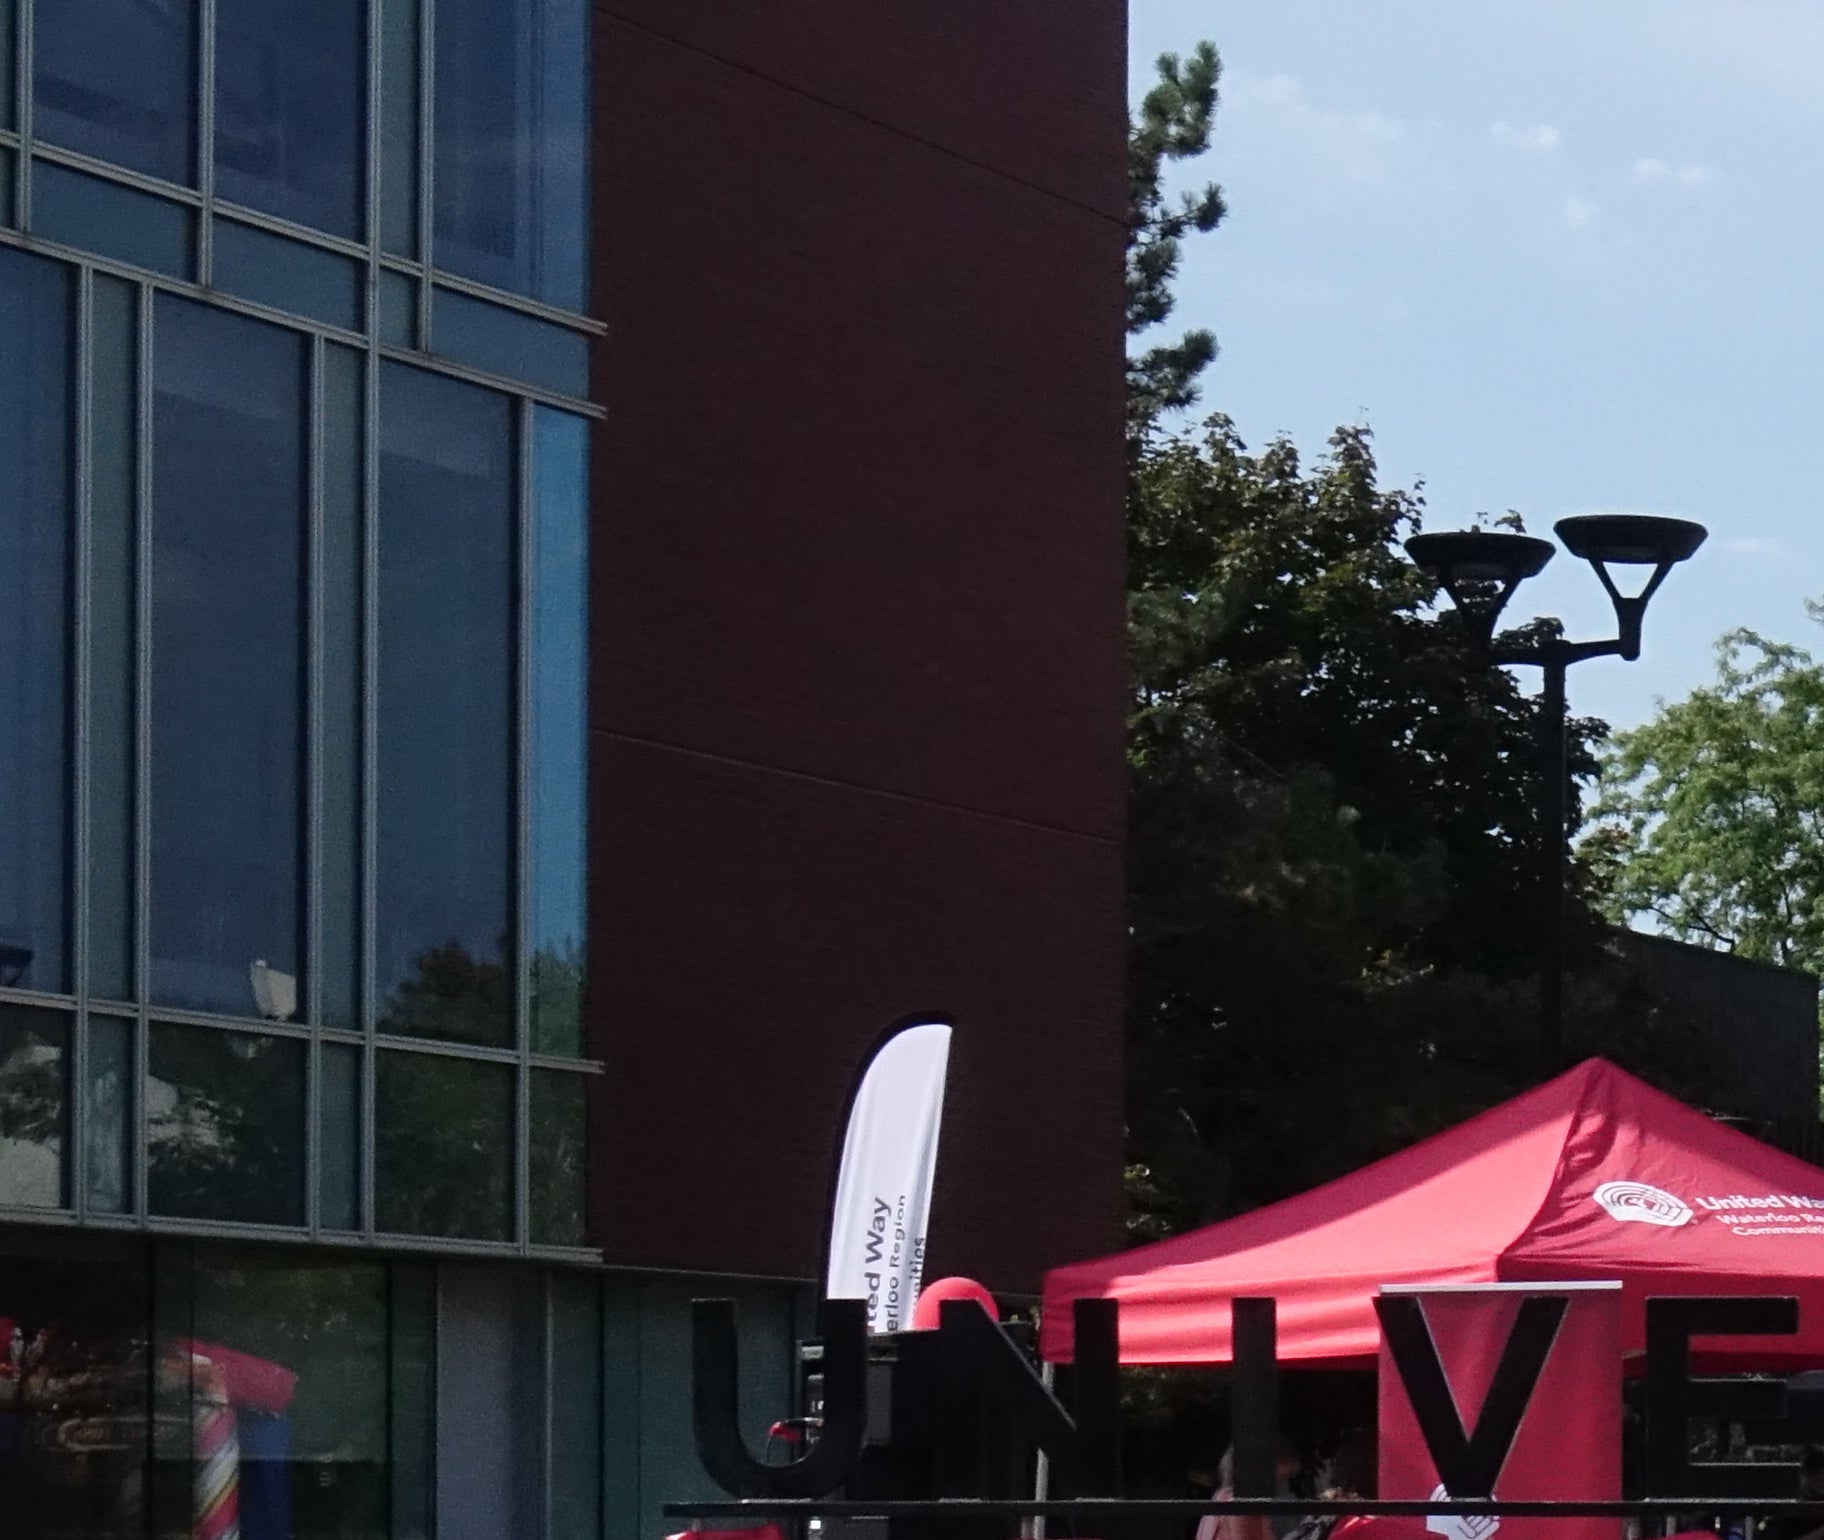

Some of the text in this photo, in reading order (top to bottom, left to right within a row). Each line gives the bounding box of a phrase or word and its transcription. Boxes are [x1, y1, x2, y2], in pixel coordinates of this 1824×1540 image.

[1696, 1194, 1784, 1210] United
[1715, 1213, 1800, 1225] Waterloo
[865, 1197, 891, 1264] Way
[885, 1195, 906, 1332] erloo Region
